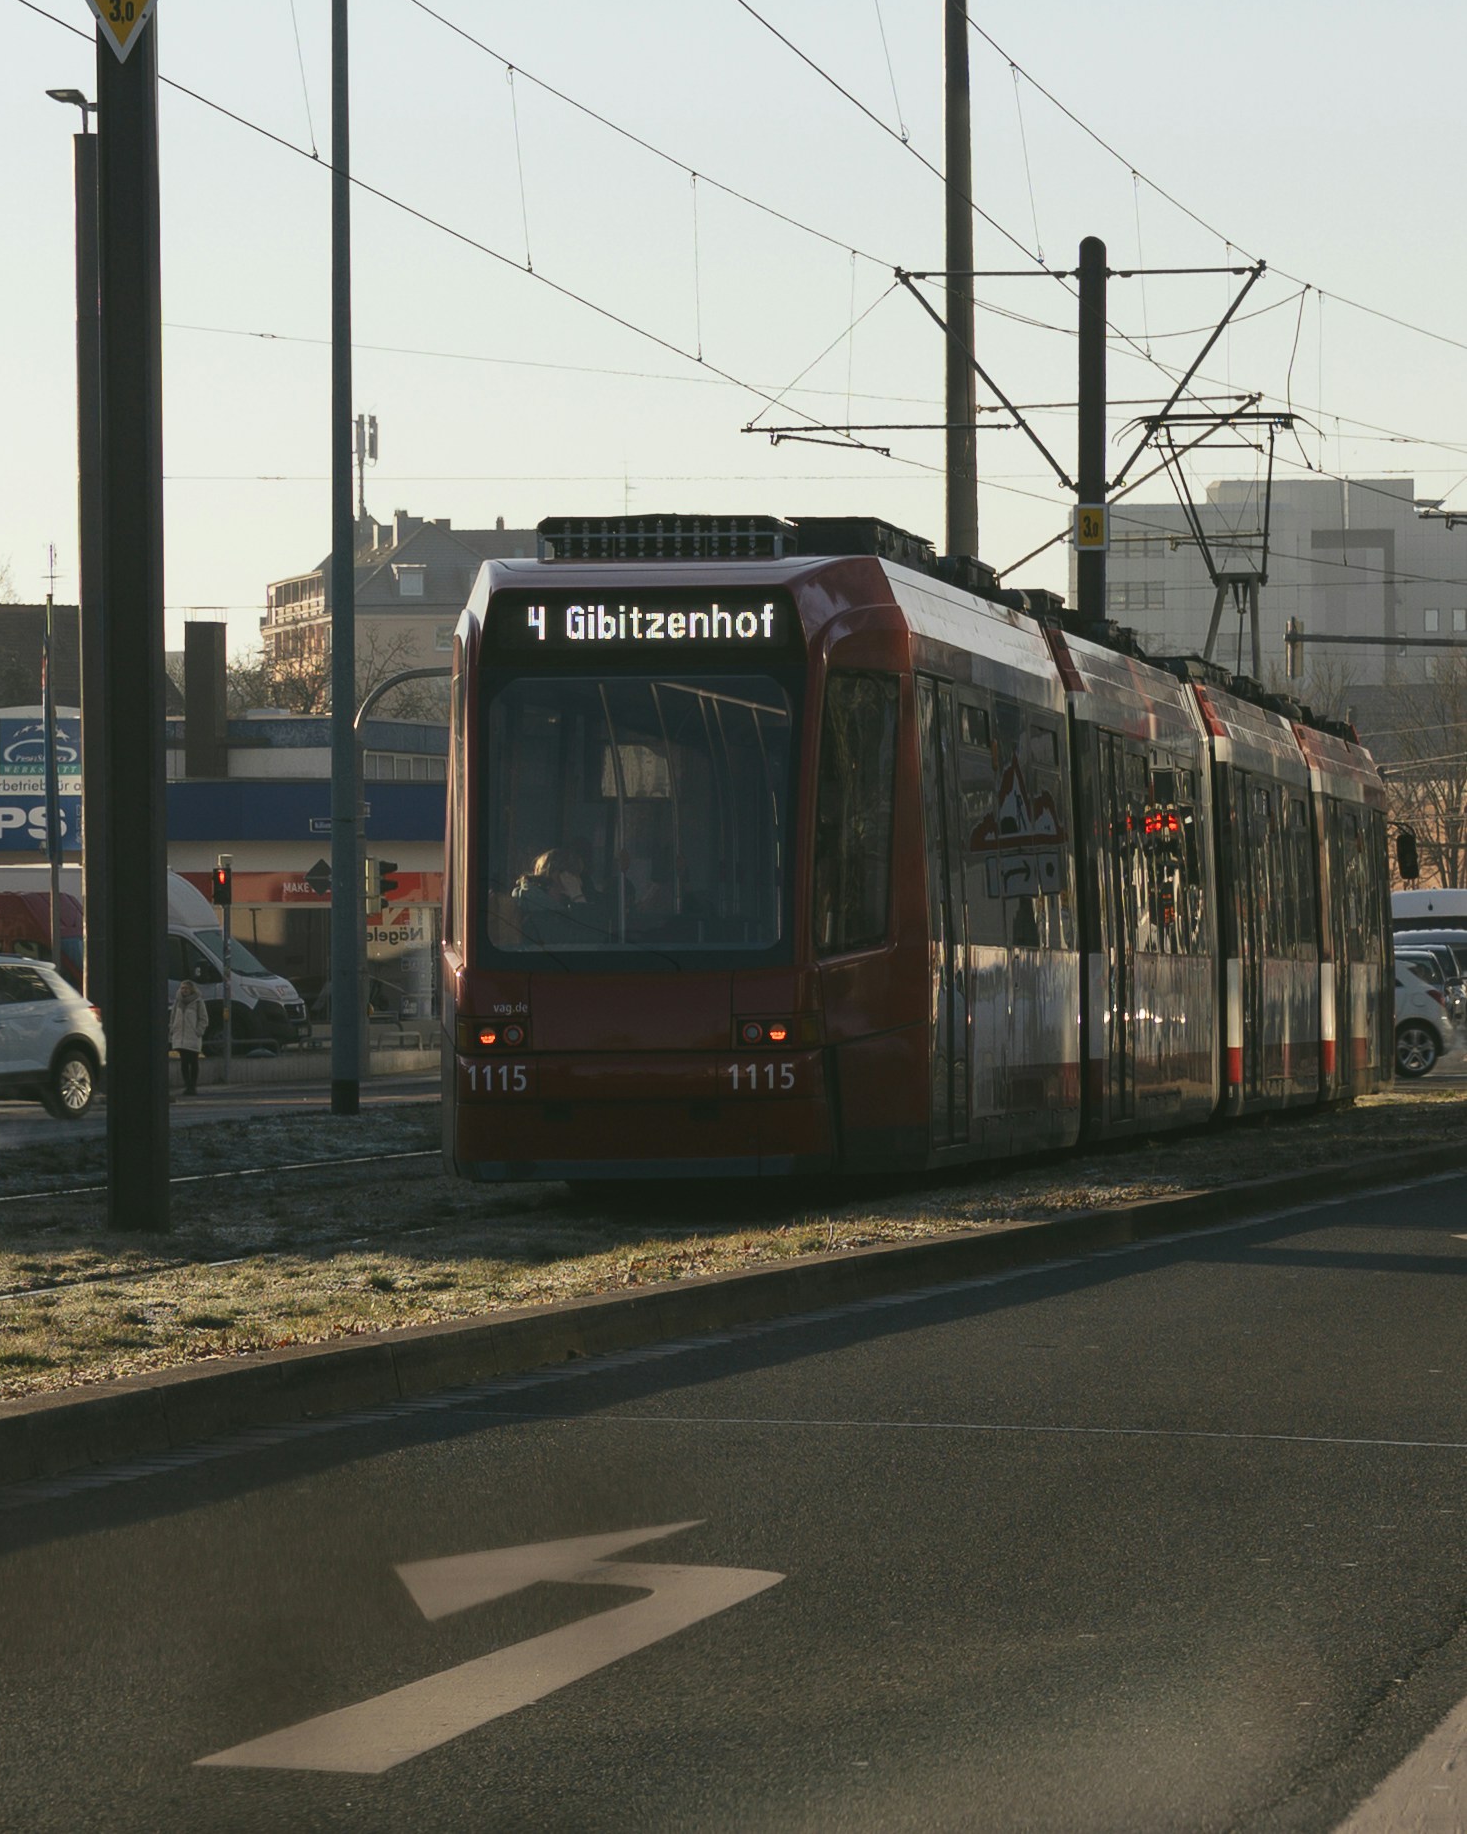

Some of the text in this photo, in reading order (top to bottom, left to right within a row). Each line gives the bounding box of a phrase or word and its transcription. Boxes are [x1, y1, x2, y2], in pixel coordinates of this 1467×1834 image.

[1083, 515, 1099, 538] 3,0
[527, 603, 774, 640] 4 Gibitzenhof
[283, 882, 310, 893] MAKE
[493, 1002, 529, 1015] vag.de
[468, 1064, 528, 1091] 1115
[728, 1063, 795, 1090] 1115
